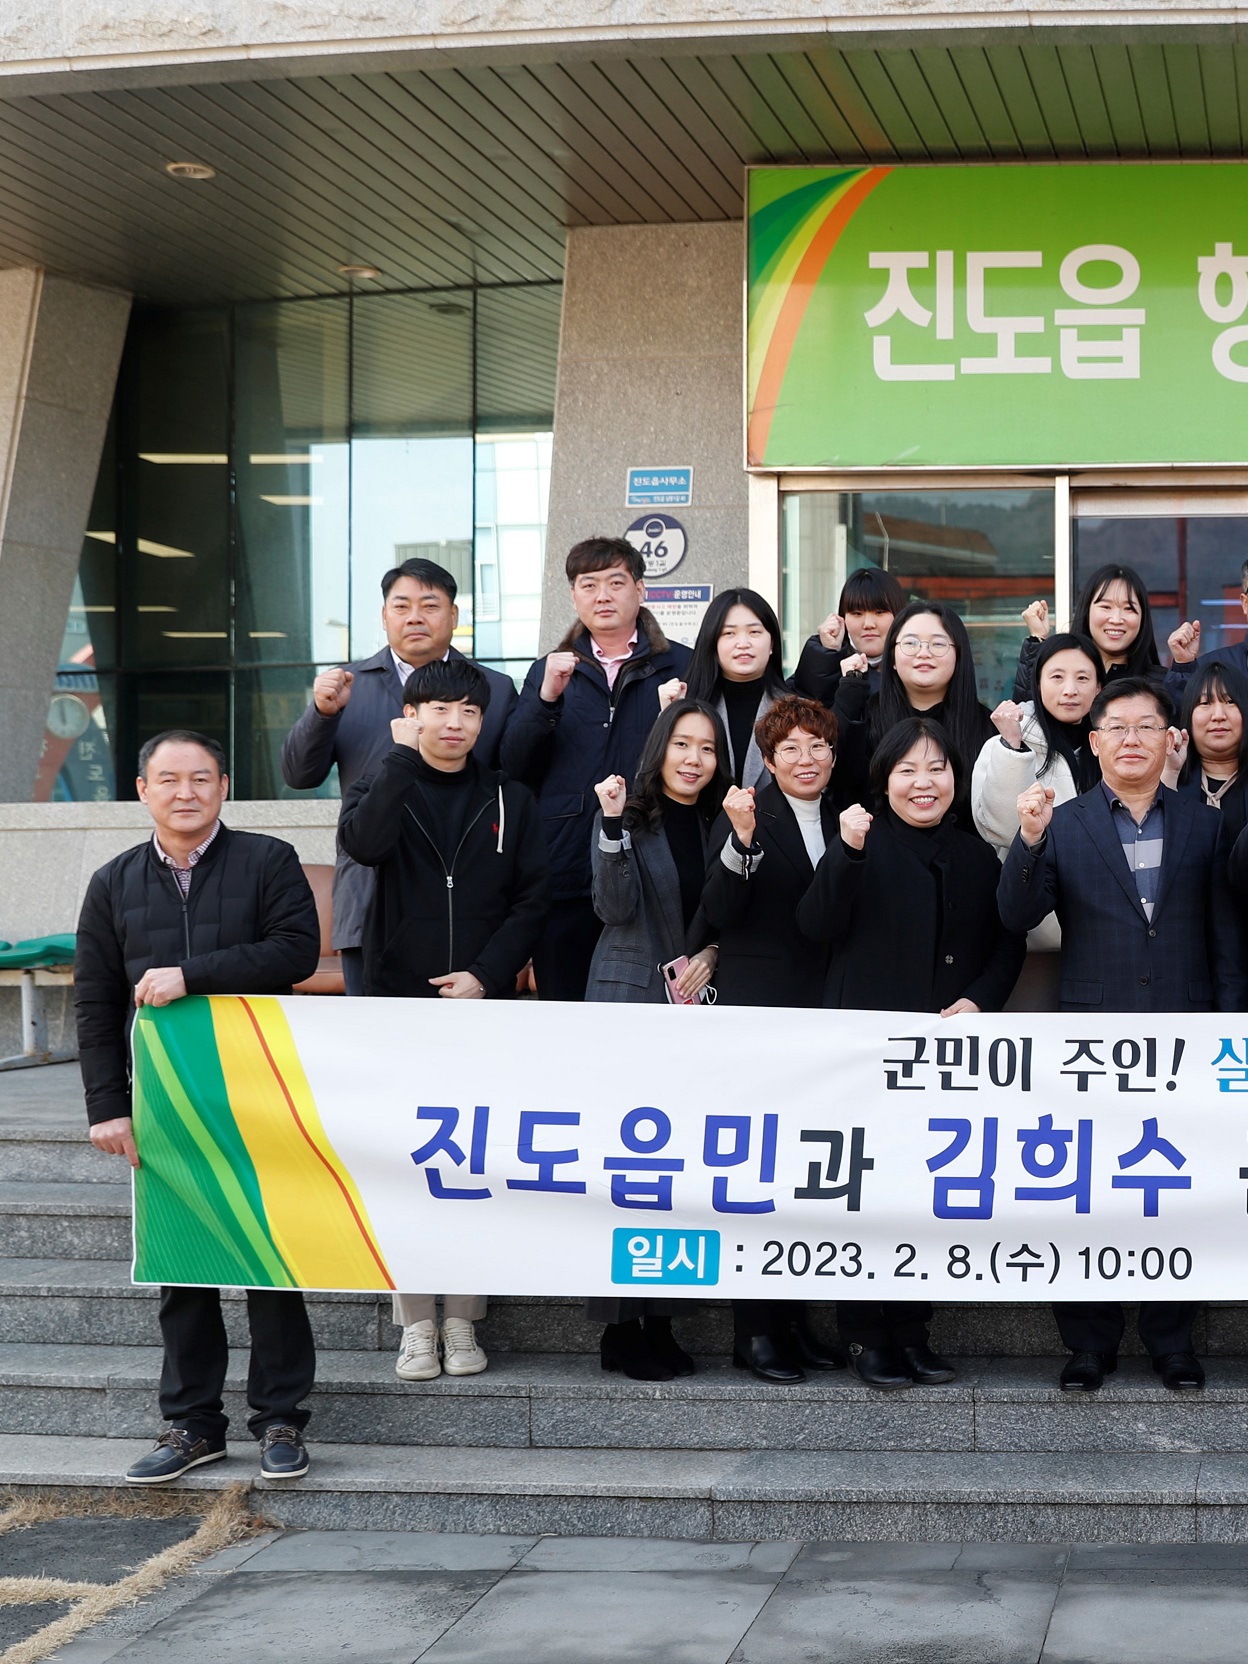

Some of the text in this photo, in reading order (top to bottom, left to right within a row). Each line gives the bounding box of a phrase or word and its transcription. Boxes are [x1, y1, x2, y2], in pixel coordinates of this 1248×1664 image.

[863, 245, 1146, 382] 진도읍
[633, 475, 688, 487] 진도읍사무소
[640, 540, 669, 558] 46
[882, 1035, 1032, 1092] 군민이
[1060, 1037, 1186, 1093] 주인!
[410, 1105, 875, 1215] 진도읍민과
[926, 1113, 1192, 1220] 김희수
[627, 1235, 706, 1279] 일시
[761, 1240, 875, 1280] 2023.
[893, 1243, 929, 1280] 2.
[1078, 1246, 1193, 1280] 10:00
